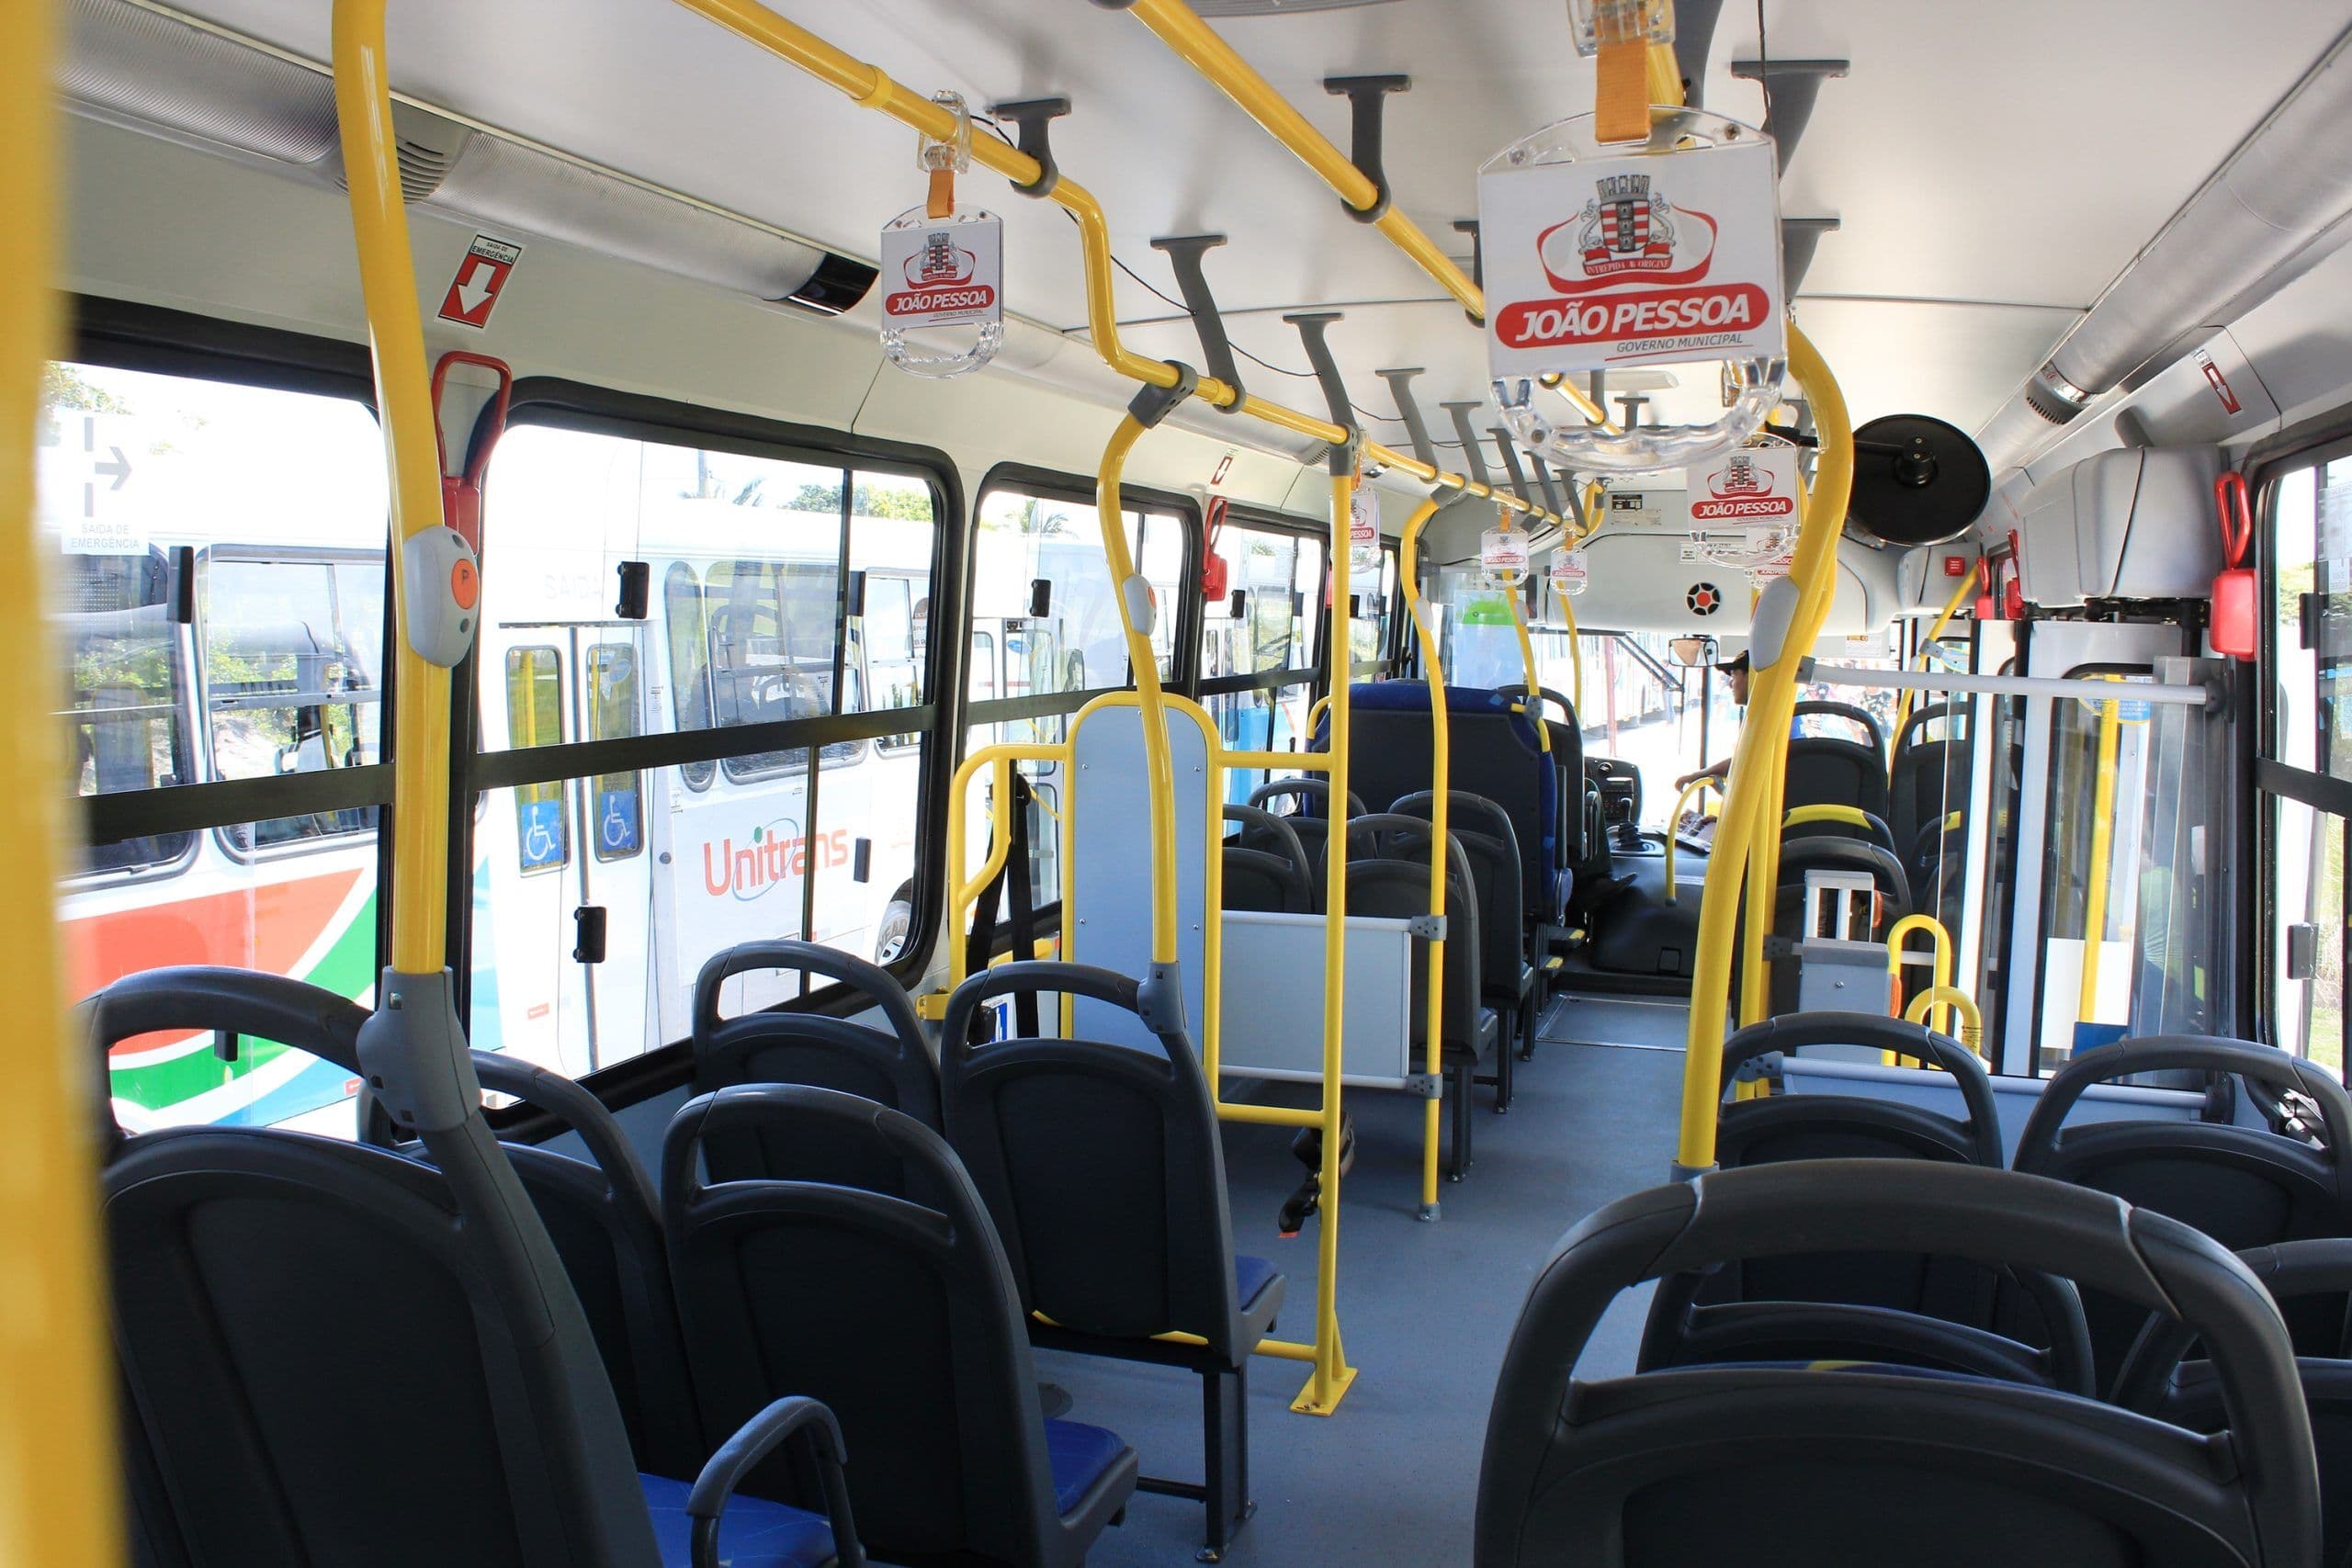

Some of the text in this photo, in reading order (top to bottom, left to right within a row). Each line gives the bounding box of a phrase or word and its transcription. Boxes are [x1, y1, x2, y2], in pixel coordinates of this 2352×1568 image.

[893, 289, 988, 312] JOÃO PESSOA
[1514, 293, 1751, 342] JOÃO PESSOA
[1616, 333, 1744, 353] GOVERNO MUNICIPAL
[1698, 501, 1787, 517] JOÃO PESSOA
[116, 525, 130, 535] DE
[72, 536, 140, 548] EMERGÊNCIA
[703, 827, 848, 897] Unitrans
